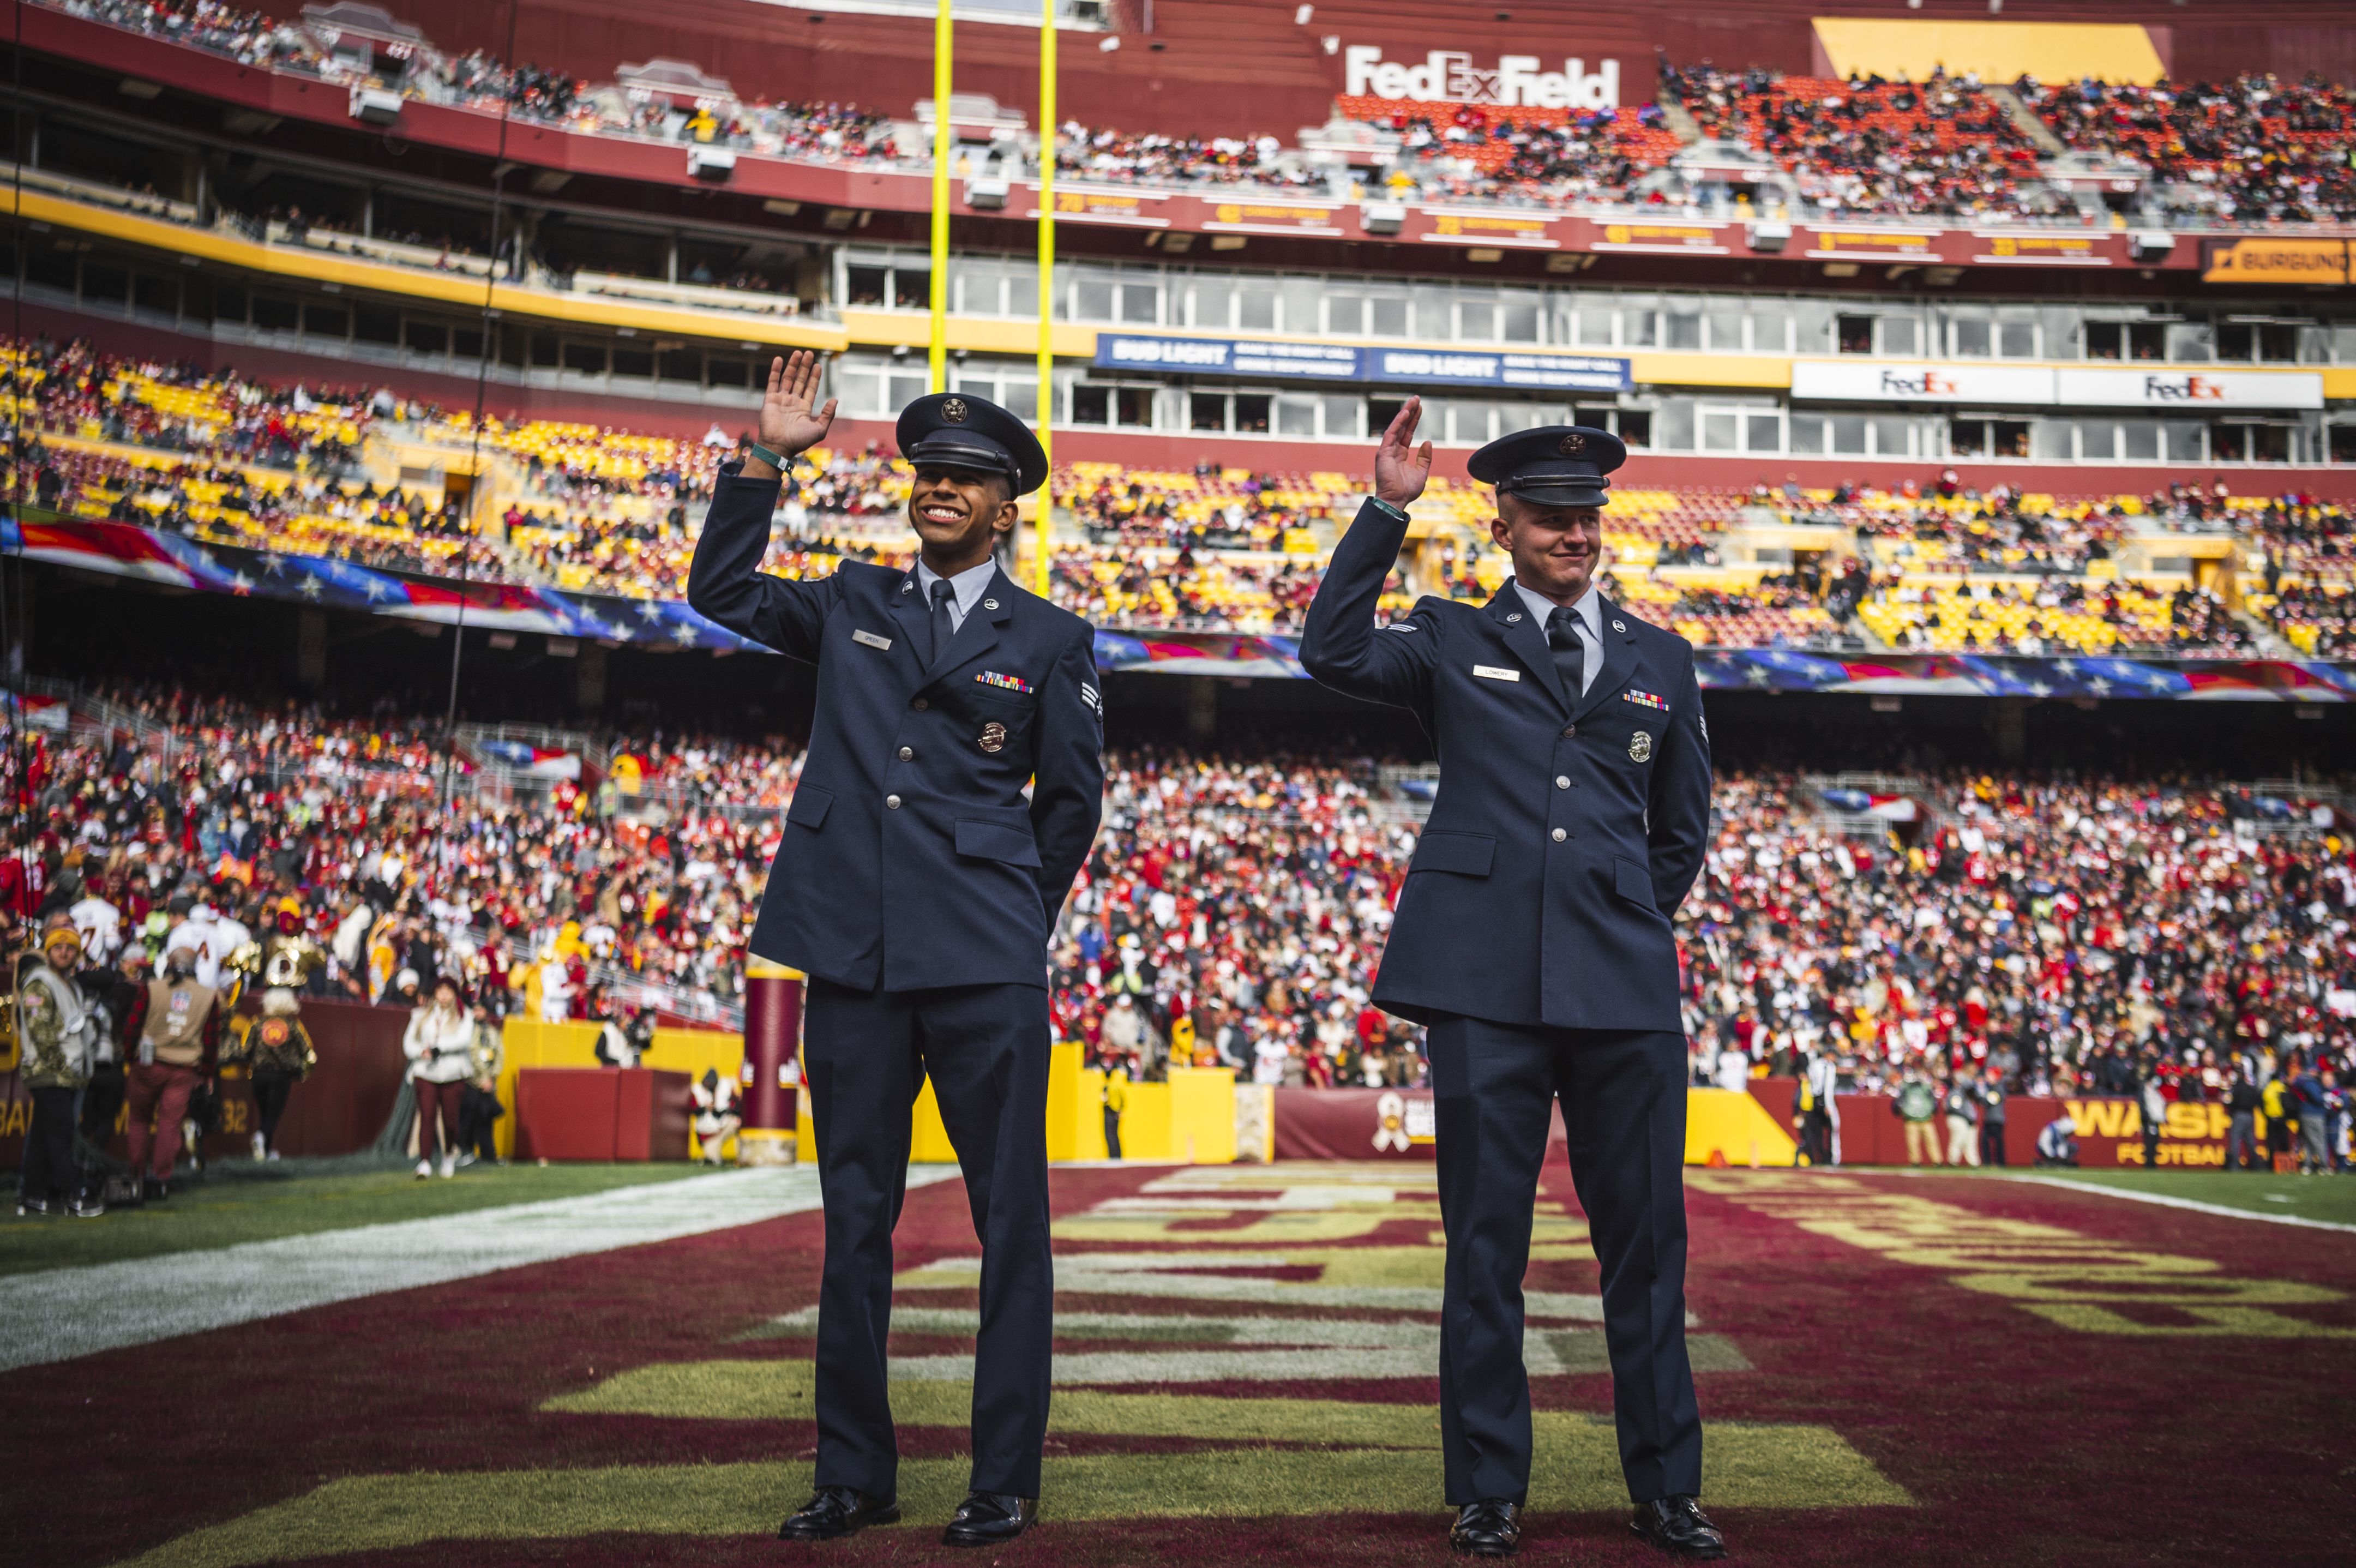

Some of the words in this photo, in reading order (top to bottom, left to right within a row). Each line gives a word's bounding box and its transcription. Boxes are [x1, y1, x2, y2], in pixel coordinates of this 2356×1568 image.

[1345, 45, 1620, 110] FedExField
[2242, 252, 2356, 272] BURGUND
[1112, 339, 1161, 362] BUD
[1161, 341, 1229, 365] LIGHT
[1384, 352, 1432, 375] BUD
[1432, 355, 1499, 378] LIGHT
[1880, 370, 1960, 395] FedEx
[2144, 375, 2225, 400] FedEx
